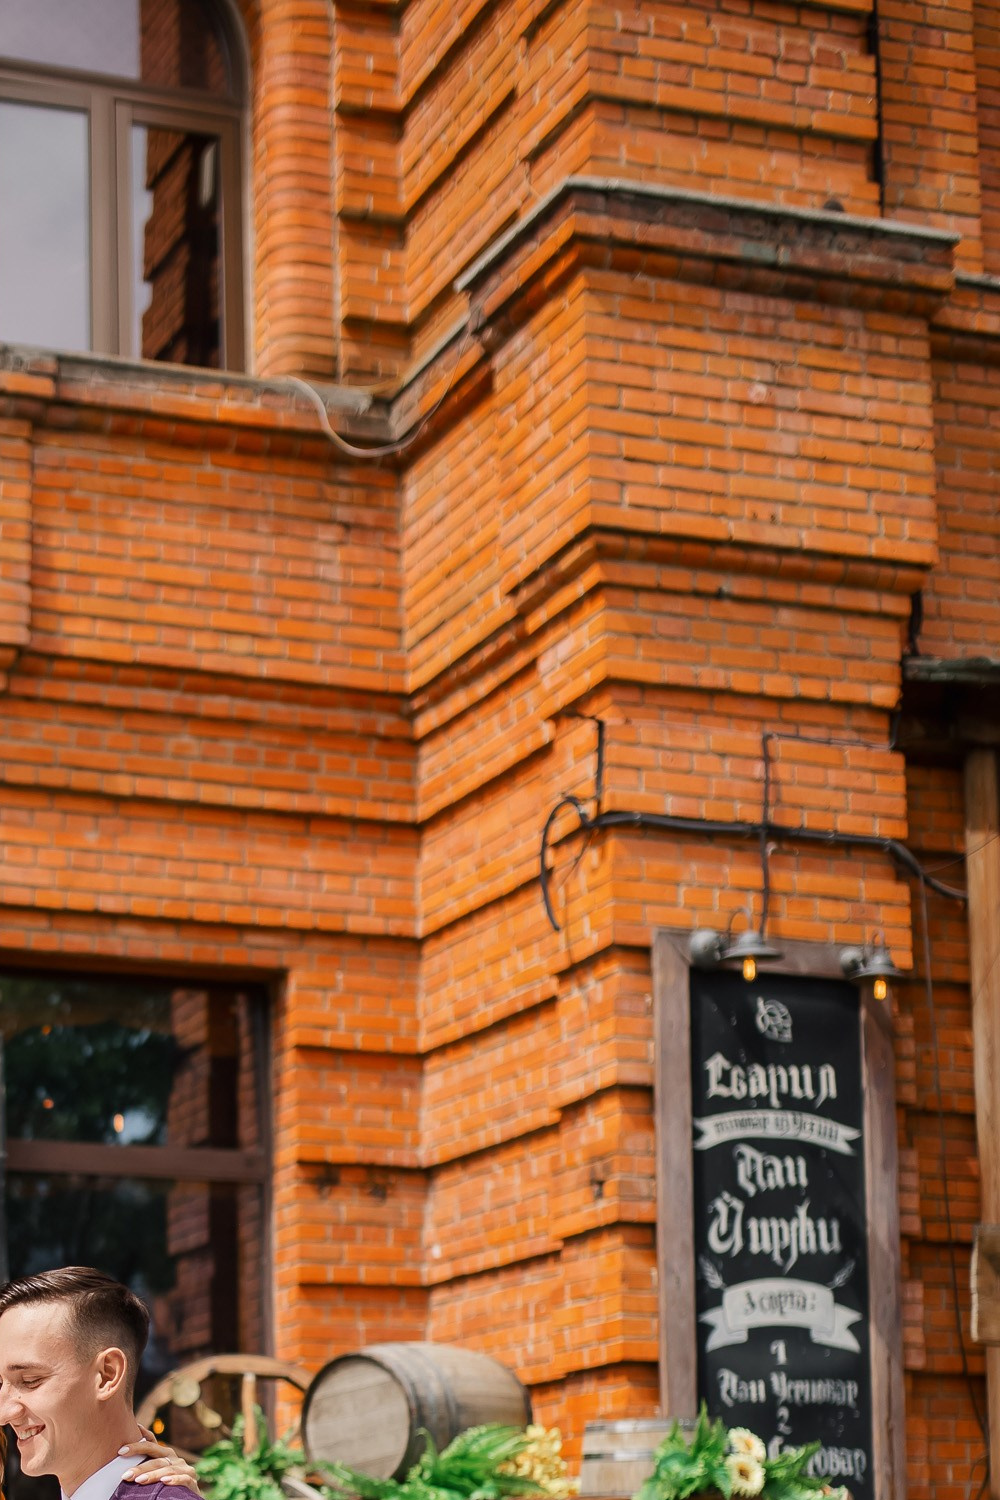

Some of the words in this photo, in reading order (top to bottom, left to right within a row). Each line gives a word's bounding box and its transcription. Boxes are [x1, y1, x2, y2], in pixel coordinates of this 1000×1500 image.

[733, 1143, 809, 1198] Пан
[770, 1339, 787, 1365] 1
[717, 1367, 767, 1408] Пан
[776, 1406, 792, 1435] 2
